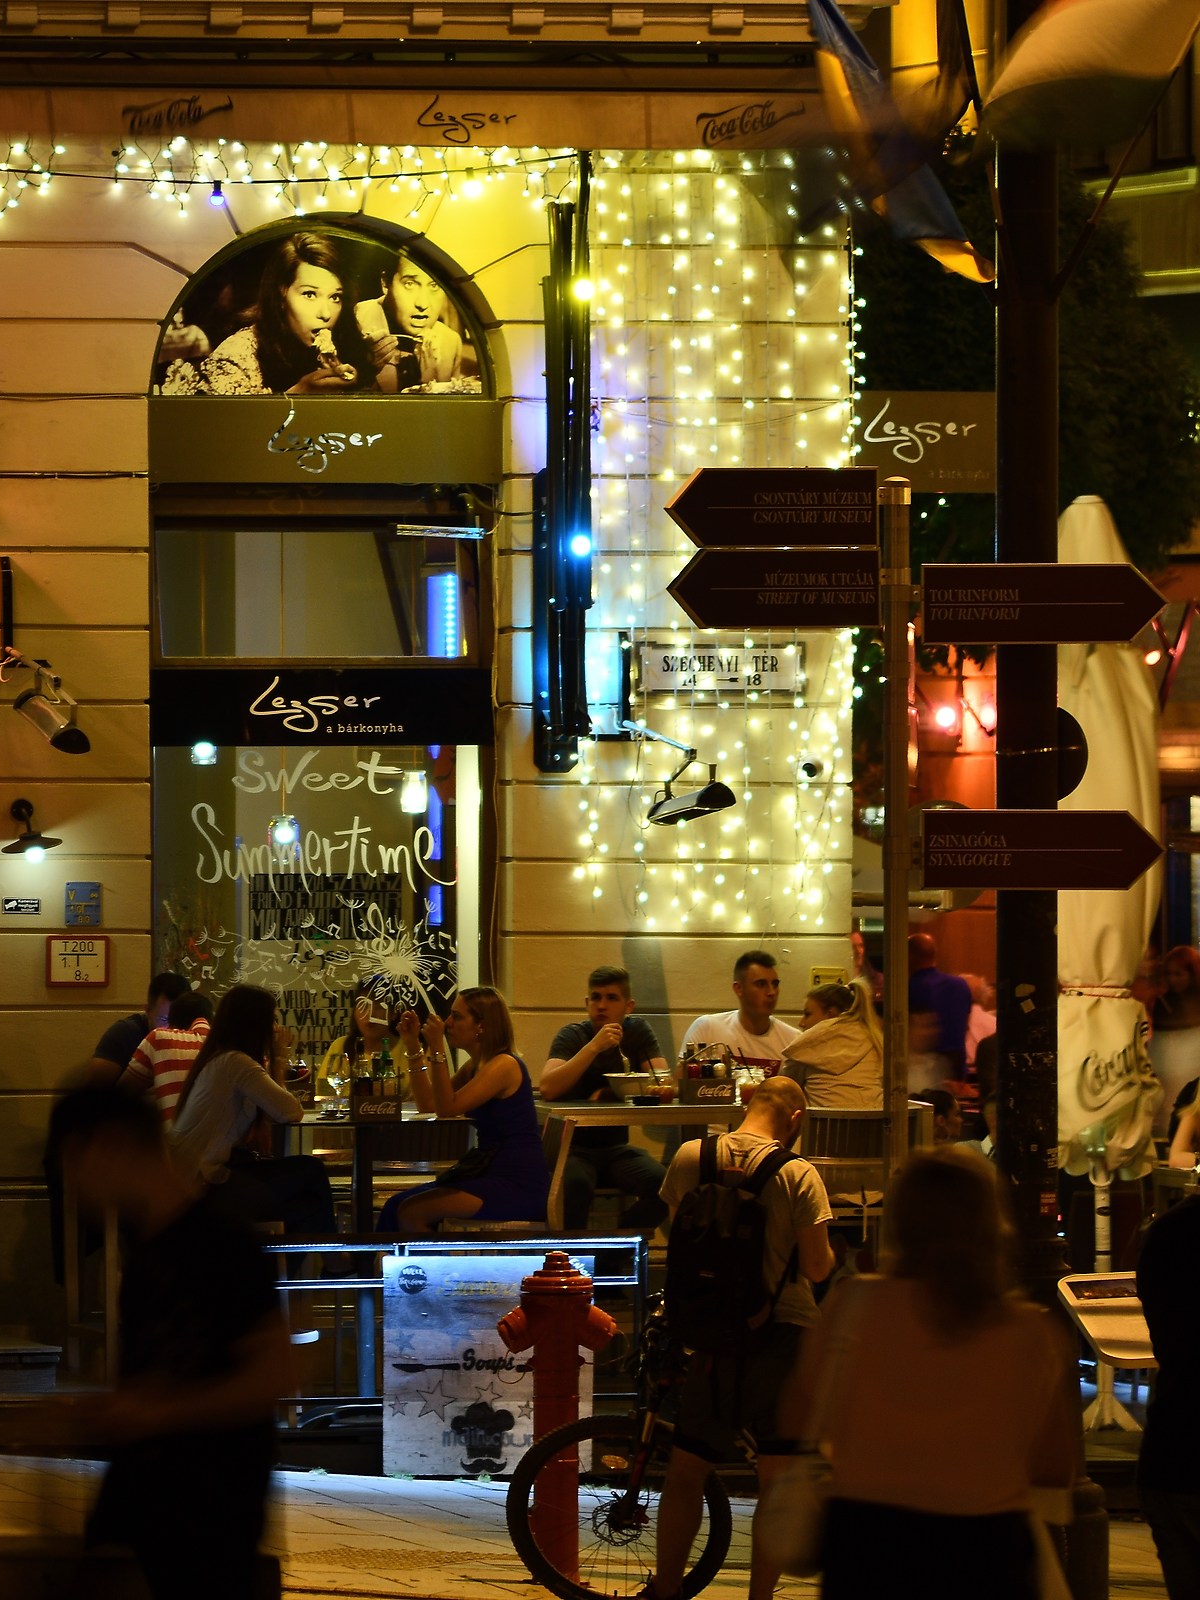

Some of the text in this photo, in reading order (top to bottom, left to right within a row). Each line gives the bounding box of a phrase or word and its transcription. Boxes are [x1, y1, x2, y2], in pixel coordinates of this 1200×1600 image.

[754, 488, 872, 505] CSONTVÁRY MÚZEUM
[823, 511, 873, 523] MUSEUM
[765, 569, 874, 586] MÚZEUMOK UTCÁJA
[757, 592, 876, 605] STREET OF MUSEUMS
[930, 589, 1020, 602] TOURINFORM
[930, 608, 1020, 621] TOURINFORM
[746, 674, 762, 686] 18
[326, 721, 404, 736] a bárkonyha
[232, 750, 403, 795] Sweet
[929, 832, 1007, 847] ZSINAGÓGA
[191, 802, 460, 894] Summertime
[929, 854, 1012, 866] SYNAGOGUE
[293, 1009, 349, 1027] VAGY?
[462, 1348, 515, 1375] Soups
